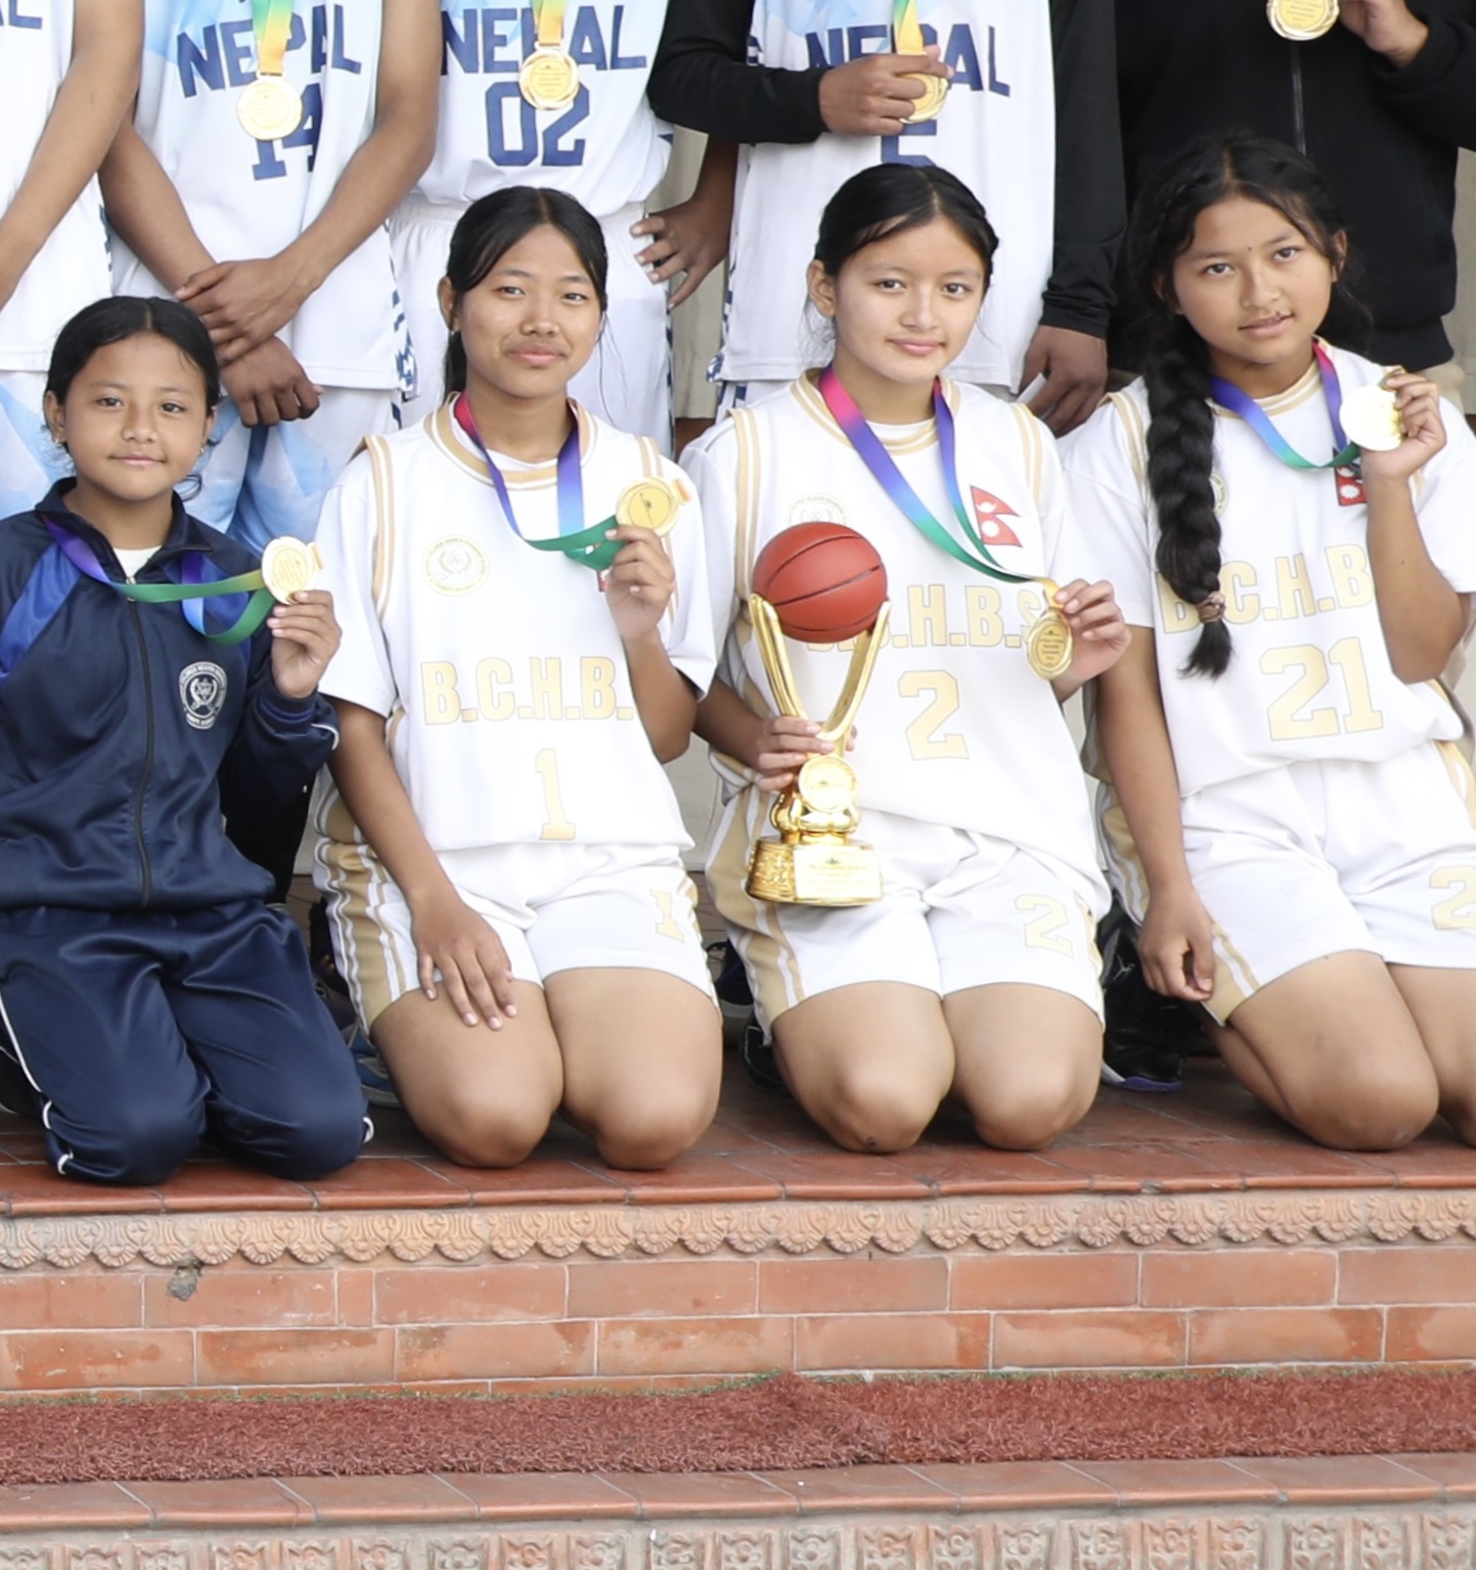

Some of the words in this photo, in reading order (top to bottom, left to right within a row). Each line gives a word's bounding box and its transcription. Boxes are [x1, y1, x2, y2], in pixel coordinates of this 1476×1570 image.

[484, 80, 591, 168] 02
[897, 669, 971, 762] 2
[1259, 637, 1385, 742] 21
[534, 747, 576, 841] 1
[648, 888, 686, 945] 1
[1013, 893, 1074, 959] 2
